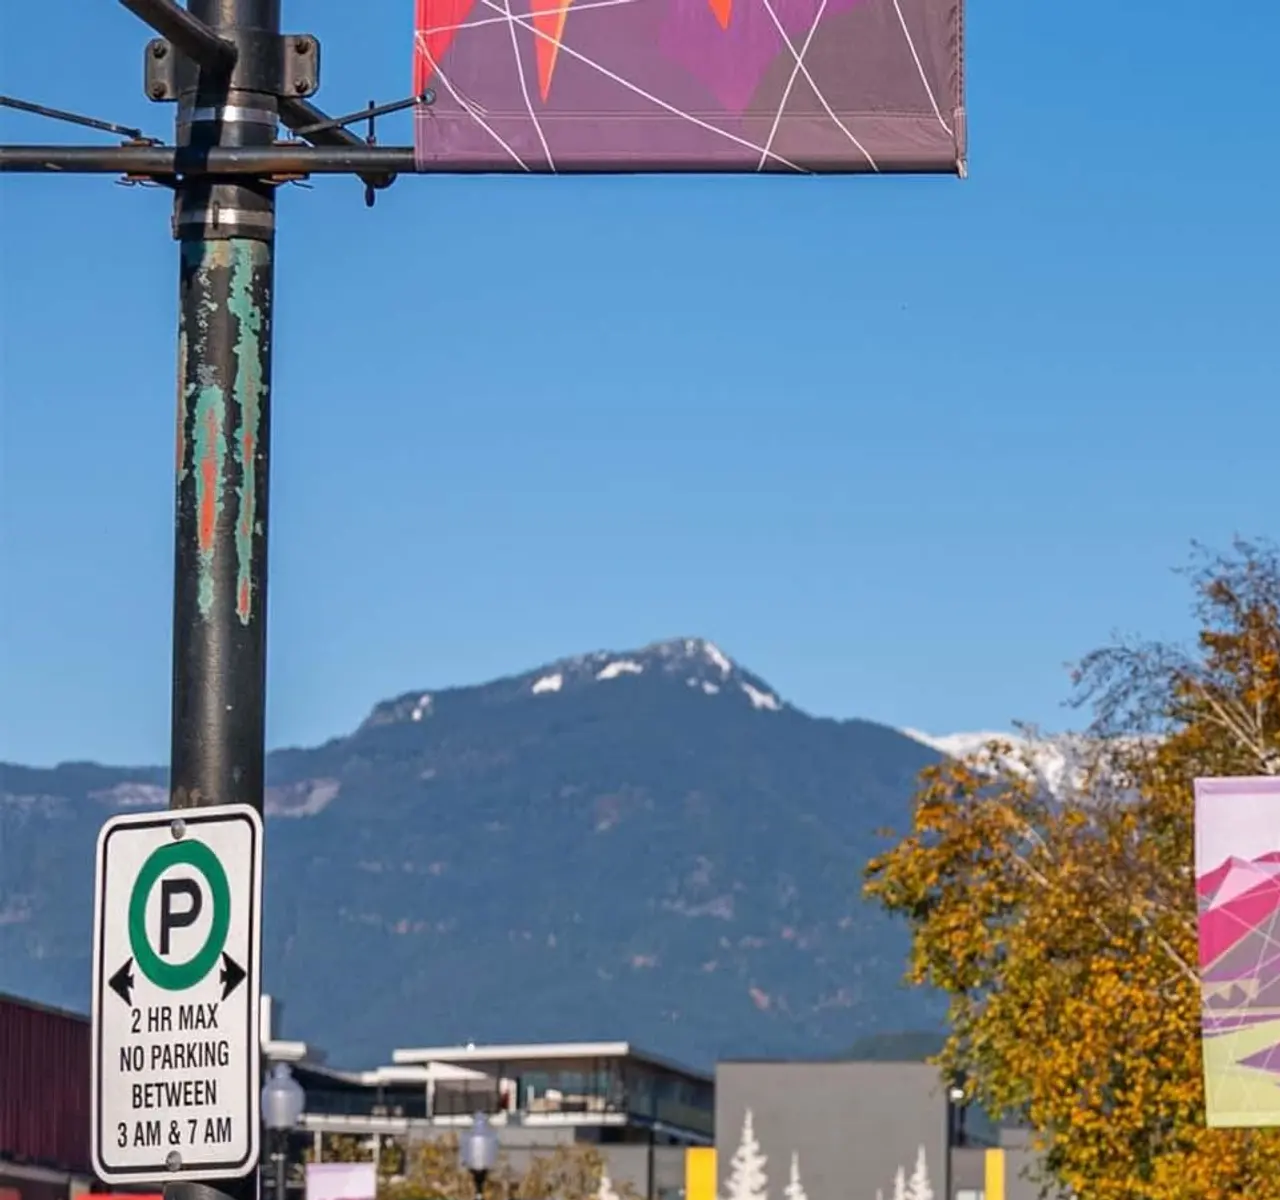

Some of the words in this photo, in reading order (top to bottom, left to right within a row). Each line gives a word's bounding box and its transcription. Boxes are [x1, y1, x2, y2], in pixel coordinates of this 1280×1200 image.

[159, 878, 203, 955] P
[131, 1007, 142, 1034] 2
[147, 1006, 172, 1032] HR
[178, 1003, 219, 1031] MAX
[120, 1045, 144, 1072] NO
[151, 1040, 229, 1071] PARKING
[132, 1079, 217, 1109] BETWEEN
[117, 1122, 128, 1148] 3
[133, 1120, 161, 1147] AM
[168, 1119, 181, 1145] &
[187, 1118, 198, 1145] 7
[204, 1116, 232, 1143] AM
